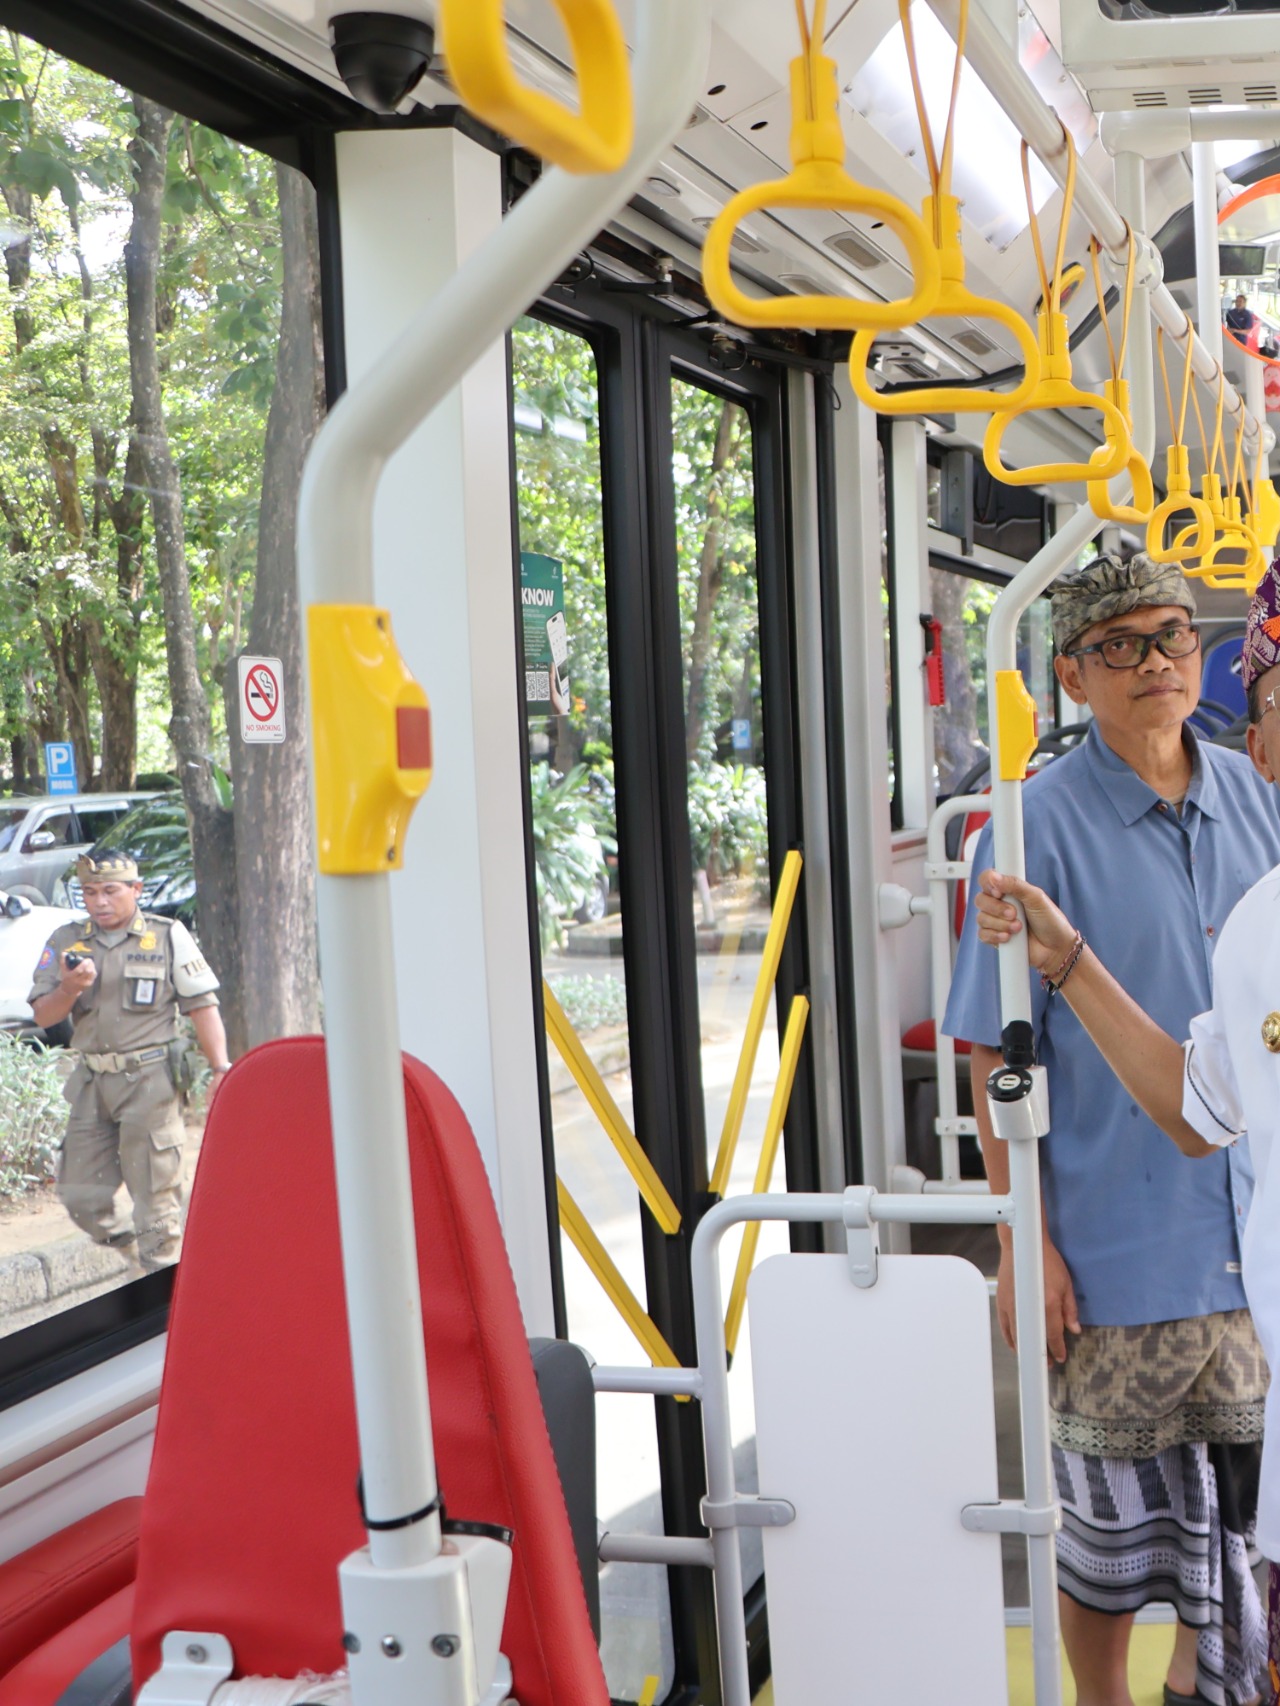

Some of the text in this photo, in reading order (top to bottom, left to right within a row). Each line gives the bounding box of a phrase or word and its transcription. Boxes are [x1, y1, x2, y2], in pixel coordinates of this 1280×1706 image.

[521, 587, 554, 607] KNOW
[256, 724, 281, 732] SMOKING
[51, 747, 69, 774] P
